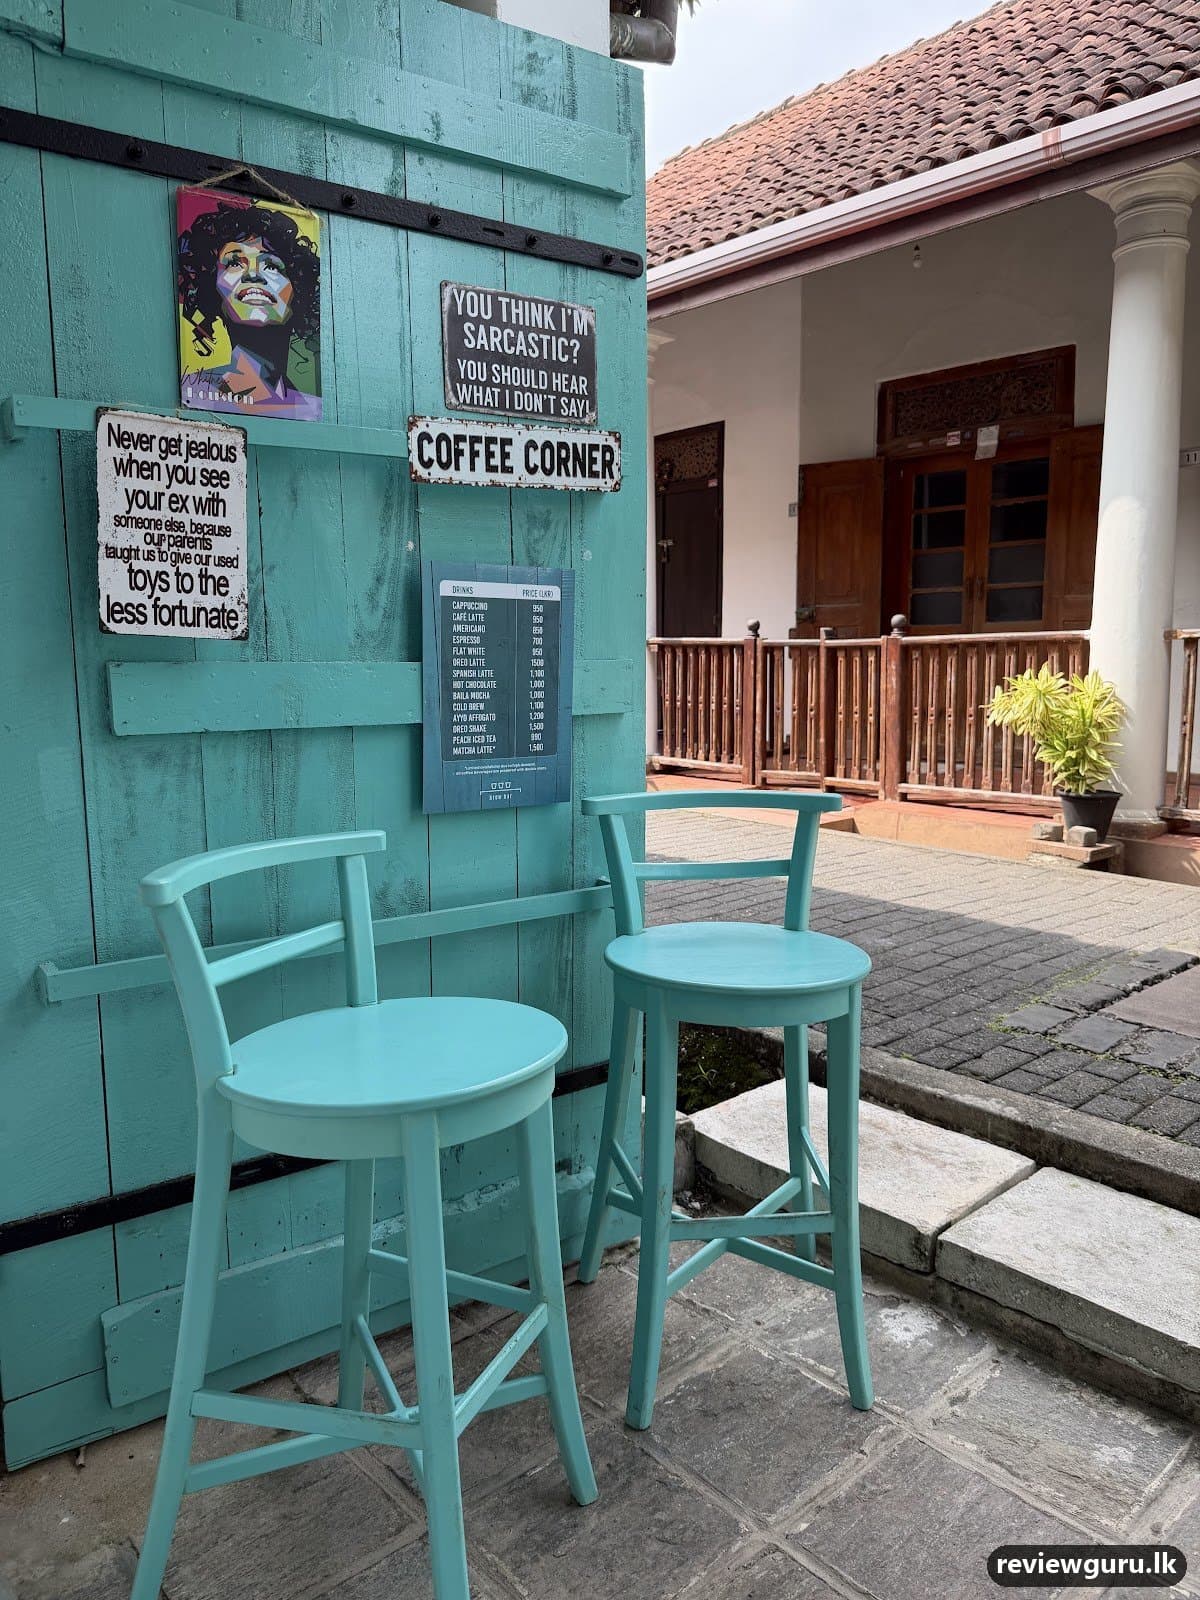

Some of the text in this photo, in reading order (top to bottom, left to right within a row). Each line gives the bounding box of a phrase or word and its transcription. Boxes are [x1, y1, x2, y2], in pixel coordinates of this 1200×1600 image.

[453, 288, 588, 336] YOU THINK I'M
[463, 322, 580, 364] SARCASTIC?
[457, 358, 588, 395] YOU SHOULD HEAR
[456, 382, 590, 418] WHAT I DON'T SAY!
[107, 422, 237, 464] Never get jealous
[417, 431, 615, 480] COFFEE CORNER
[113, 452, 230, 490] when you see
[124, 488, 226, 518] your ex with
[114, 514, 232, 538] someone else, because
[144, 532, 212, 552] our parents
[105, 544, 239, 569] taught us to give our used
[127, 562, 230, 600] toys to the
[452, 585, 474, 595] DRINKS
[522, 589, 538, 598] PRICE
[452, 601, 488, 611] CAPPUCCINO
[532, 604, 544, 613] 950
[106, 594, 239, 630] less fortunate
[452, 612, 485, 622] CAFÉ LATTE
[532, 615, 544, 624] 950
[452, 624, 486, 633] AMERICANO
[452, 636, 481, 645] ESPRESSO
[532, 637, 543, 646] 700
[452, 647, 486, 656] FLAT WHITE
[452, 658, 486, 667] OREO LATTE
[452, 669, 494, 678] SPANISH LATTE
[452, 680, 497, 689] HOT CHOCOLATE
[452, 691, 490, 700] BAILA MOCHA
[452, 703, 485, 711] COLD BREW
[452, 713, 496, 723] AYYO AFFOGATO
[529, 712, 544, 721] 1,200
[452, 724, 487, 734] OREO SHAKE
[529, 723, 544, 731] 1,500
[452, 735, 497, 744] PEACH ICED TEA
[452, 746, 476, 755] MATCHA
